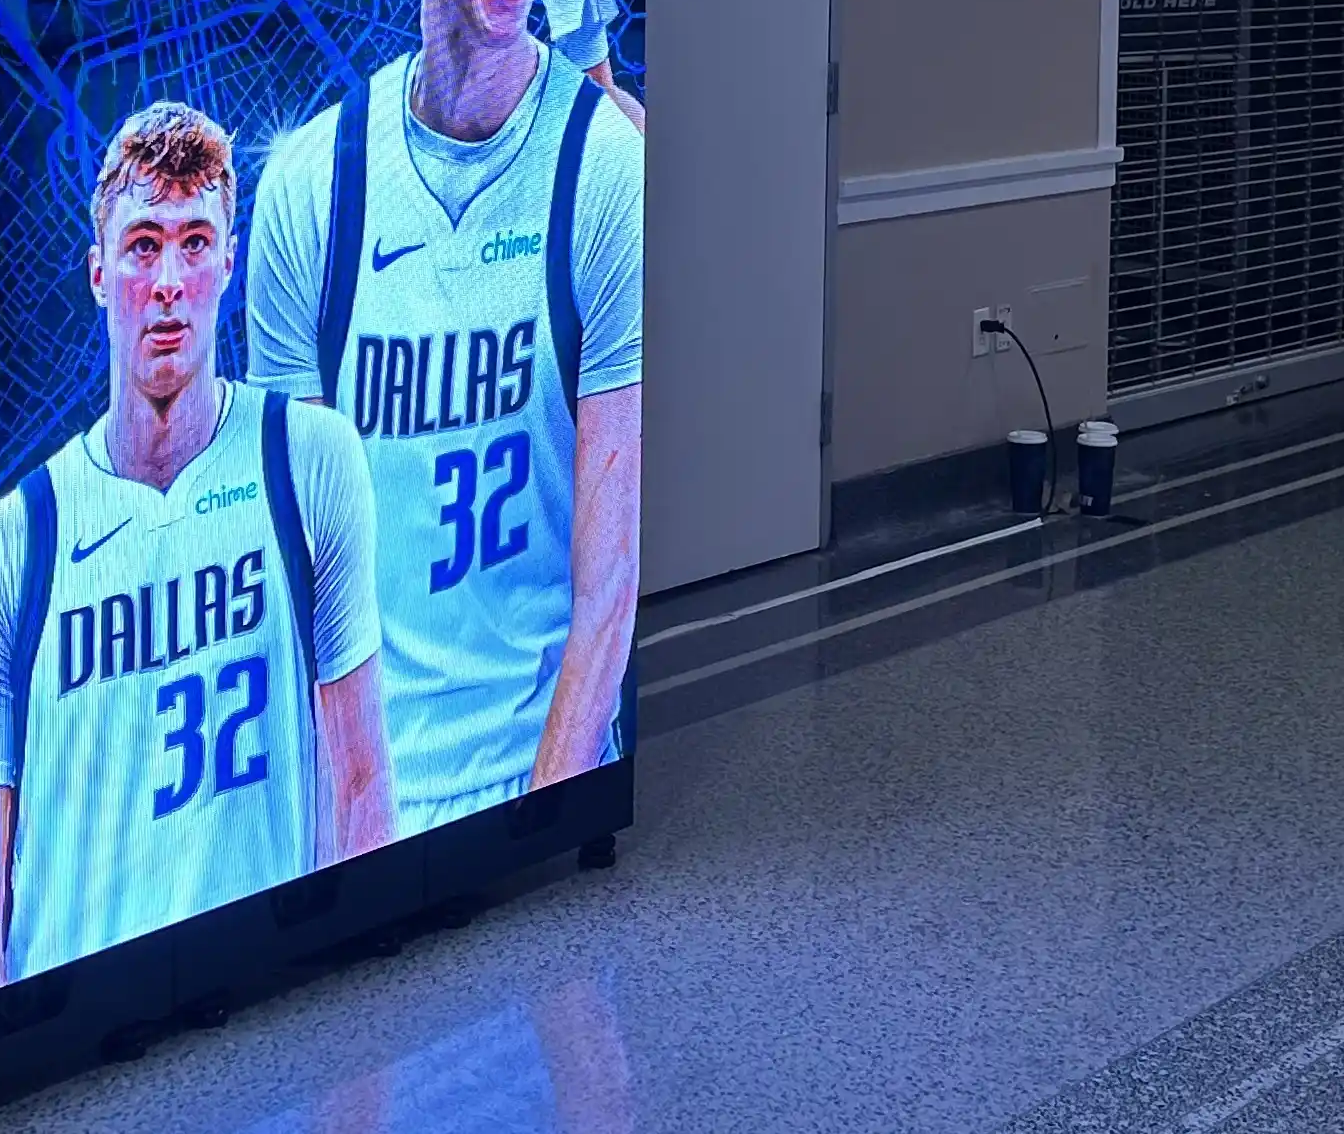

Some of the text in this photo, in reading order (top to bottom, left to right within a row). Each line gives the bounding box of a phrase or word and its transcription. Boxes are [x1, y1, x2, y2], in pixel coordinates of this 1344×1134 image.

[480, 229, 542, 266] chime
[355, 316, 537, 439] DALLAS
[194, 481, 258, 516] chime
[429, 430, 532, 595] 32
[58, 546, 266, 702] DALLAS
[153, 653, 271, 821] 32
